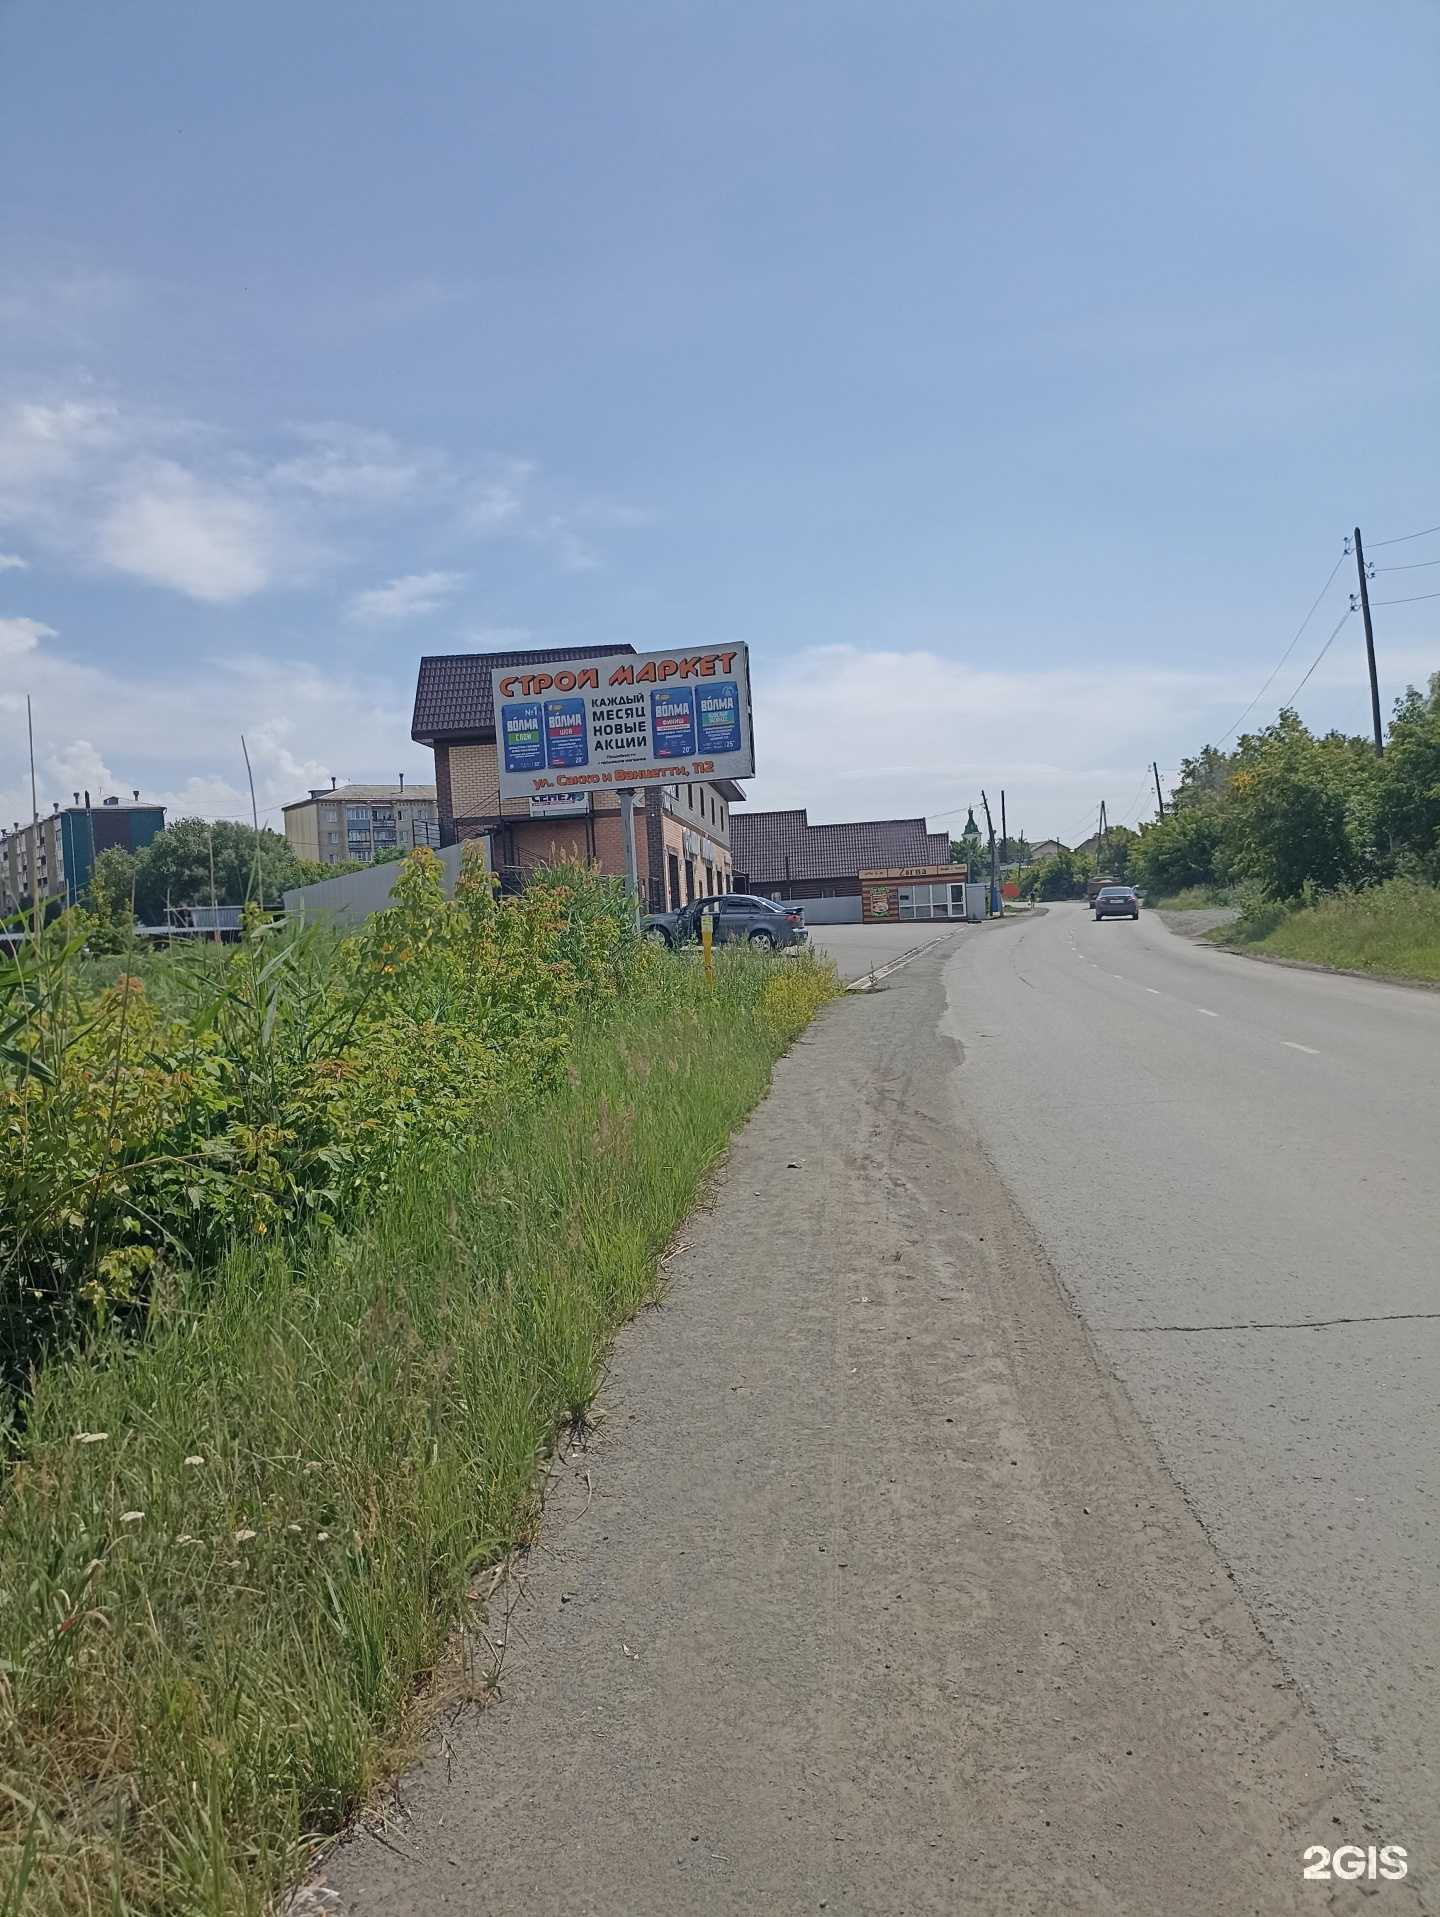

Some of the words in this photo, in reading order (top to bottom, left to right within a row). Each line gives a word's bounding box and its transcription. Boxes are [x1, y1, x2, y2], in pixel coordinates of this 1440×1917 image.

[500, 668, 599, 697] СТРОЙ
[609, 652, 737, 685] МАРКЕТ
[592, 693, 644, 707] КАЖДЫЙ
[593, 707, 646, 721] МЕСЯЦ
[593, 721, 647, 736] НОВЫЕ
[595, 736, 647, 751] АКЦИИ
[533, 778, 554, 790] ул.
[557, 775, 600, 786] Сакко
[602, 773, 612, 782] и
[693, 761, 714, 773] 112
